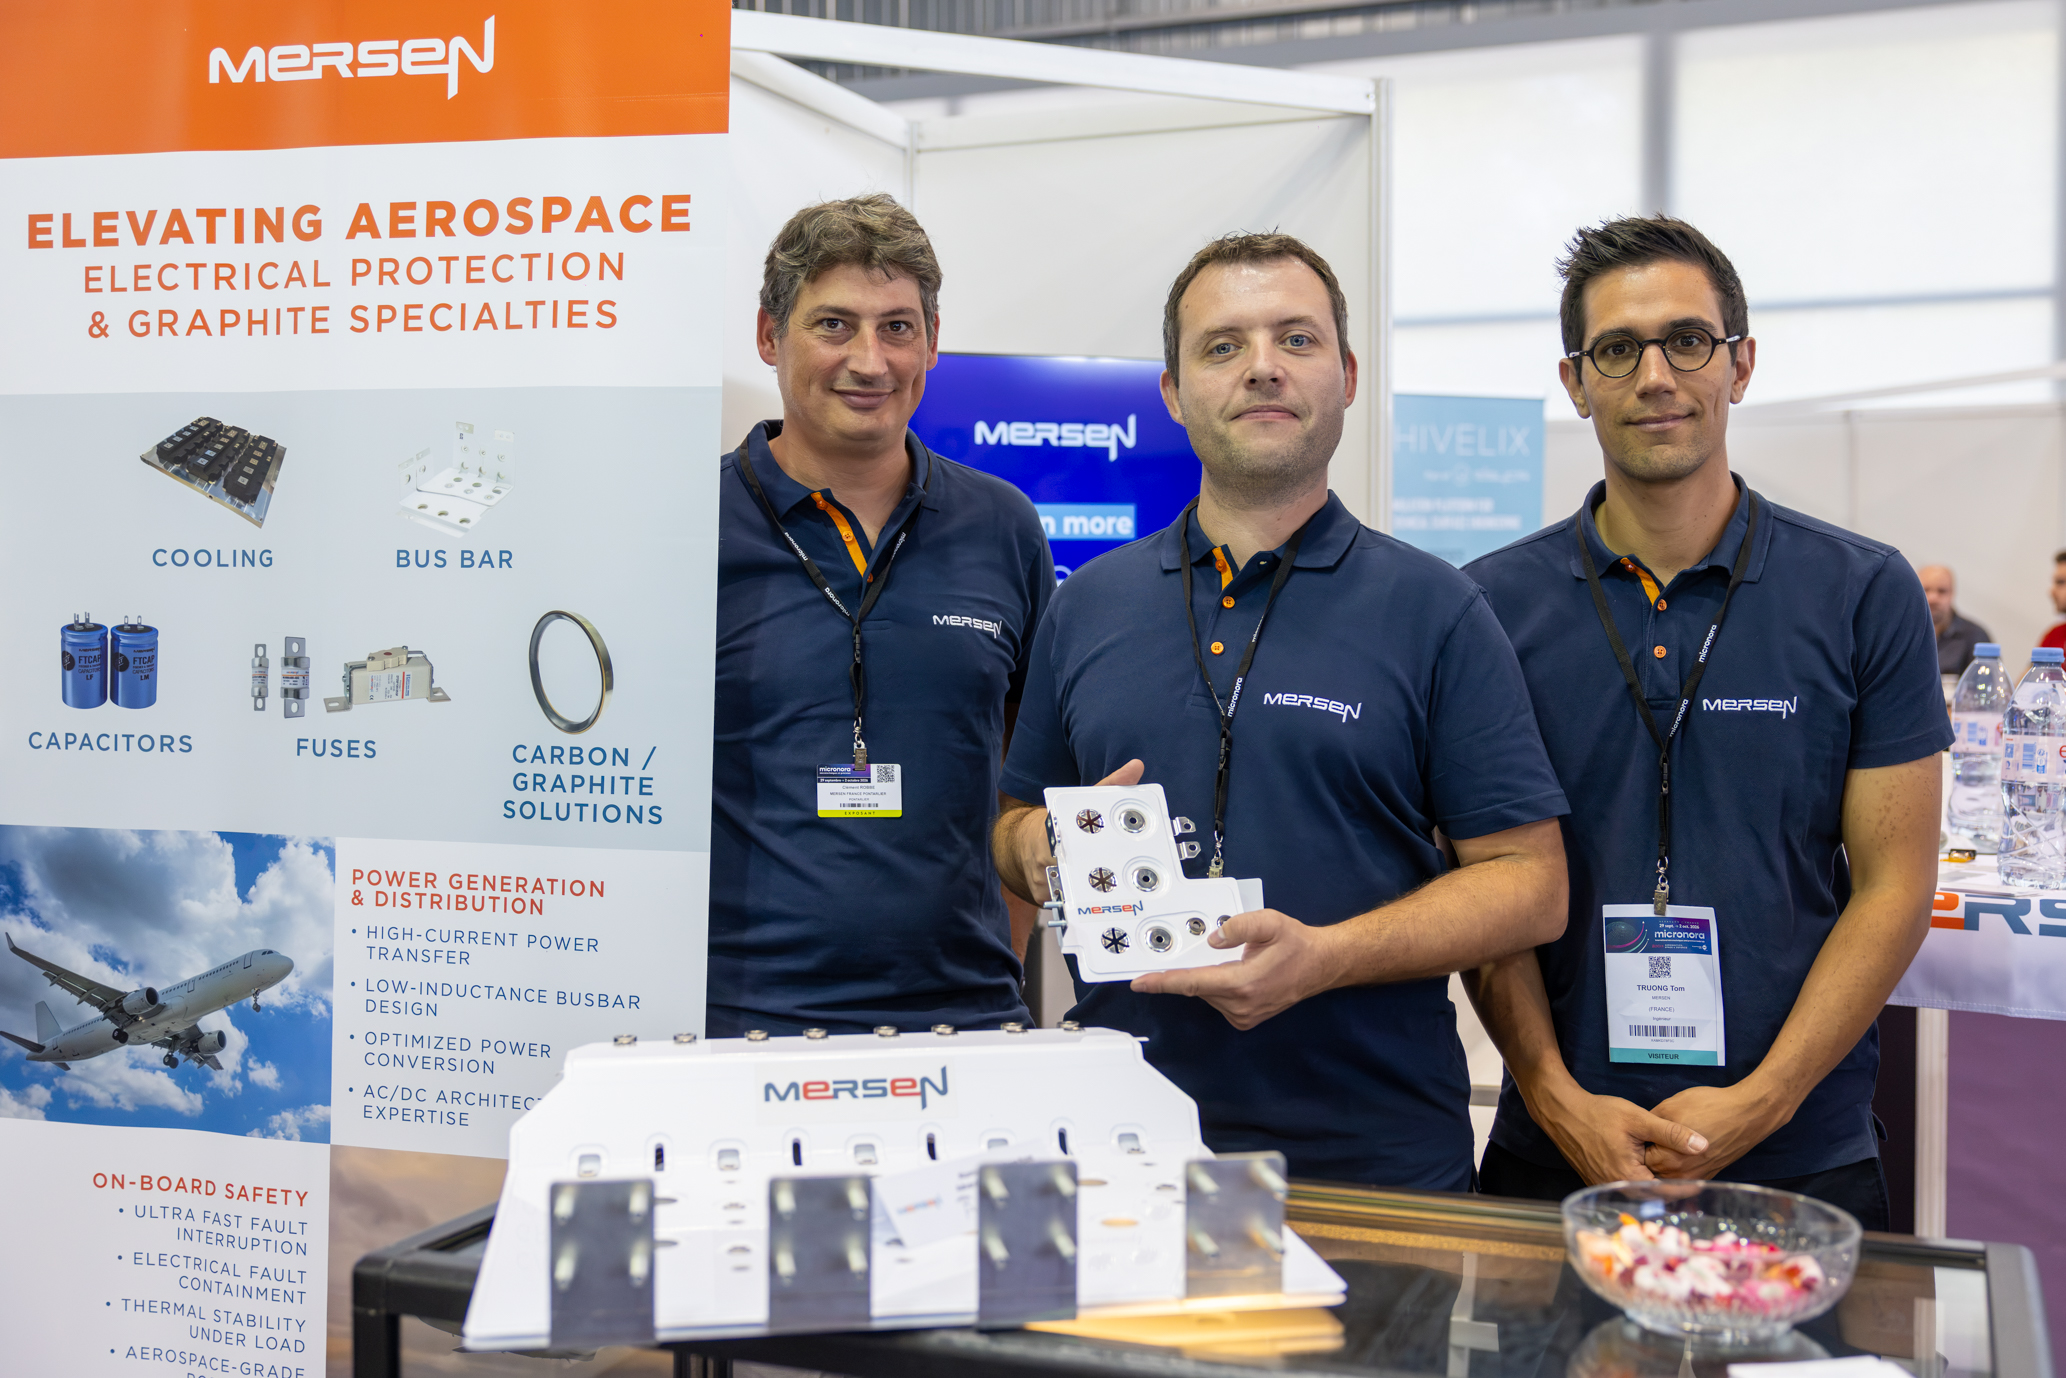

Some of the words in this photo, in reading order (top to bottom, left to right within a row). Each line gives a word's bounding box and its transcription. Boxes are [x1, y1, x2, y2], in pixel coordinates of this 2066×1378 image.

[29, 205, 321, 249] ELEVATING
[346, 195, 691, 239] AEROSPACE
[85, 260, 330, 293] ELECTRICAL
[352, 252, 623, 286] PROTECTION
[89, 311, 109, 338] &
[129, 306, 329, 337] GRAPHITE
[350, 300, 617, 333] SPECIALTIES
[1063, 515, 1133, 535] more
[153, 549, 272, 567] COOLING
[397, 550, 446, 568] BUS
[461, 550, 512, 568] BAR
[1698, 624, 1717, 663] micronora
[1227, 677, 1243, 718] micronora
[29, 732, 192, 752] CAPACITORS
[297, 738, 376, 758] FUSES
[513, 745, 628, 766] CARBON
[642, 747, 656, 770] /
[513, 773, 653, 795] GRAPHITE
[503, 800, 662, 824] SOLUTIONS
[353, 869, 436, 888] POWER
[449, 874, 604, 897] GENERATION
[352, 890, 363, 905] &
[376, 891, 542, 915] DISTRIBUTION
[368, 926, 518, 946] HIGH-CURRENT
[528, 935, 598, 952] POWER
[1654, 929, 1705, 939] micronora
[367, 946, 469, 965] TRANSFER
[366, 979, 546, 1004] LOW-INDUCTANCE
[557, 991, 639, 1009] BUSBAR
[366, 999, 437, 1016] DESIGN
[365, 1032, 471, 1051] OPTIMIZED
[481, 1038, 551, 1058] POWER
[365, 1052, 493, 1074] CONVERSION
[364, 1085, 426, 1102] AC/DC
[436, 1090, 543, 1110] ARCHITEC
[364, 1105, 468, 1126] EXPERTISE
[93, 1173, 215, 1196] ON-BOARD
[225, 1183, 308, 1206] SAFETY
[135, 1205, 195, 1221] ULTRA
[204, 1211, 242, 1228] FAST
[252, 1218, 307, 1235] FAULT
[178, 1227, 307, 1256] INTERRUPTION
[134, 1252, 240, 1277] ELECTRICAL
[250, 1266, 306, 1284] FAULT
[179, 1275, 306, 1304] CONTAINMENT
[122, 1299, 205, 1320] THERMAL
[214, 1309, 305, 1332] STABILITY
[190, 1326, 245, 1346] UNDER
[256, 1336, 304, 1352] LOAD
[126, 1345, 305, 1378] AEROSPACE-GRADE
